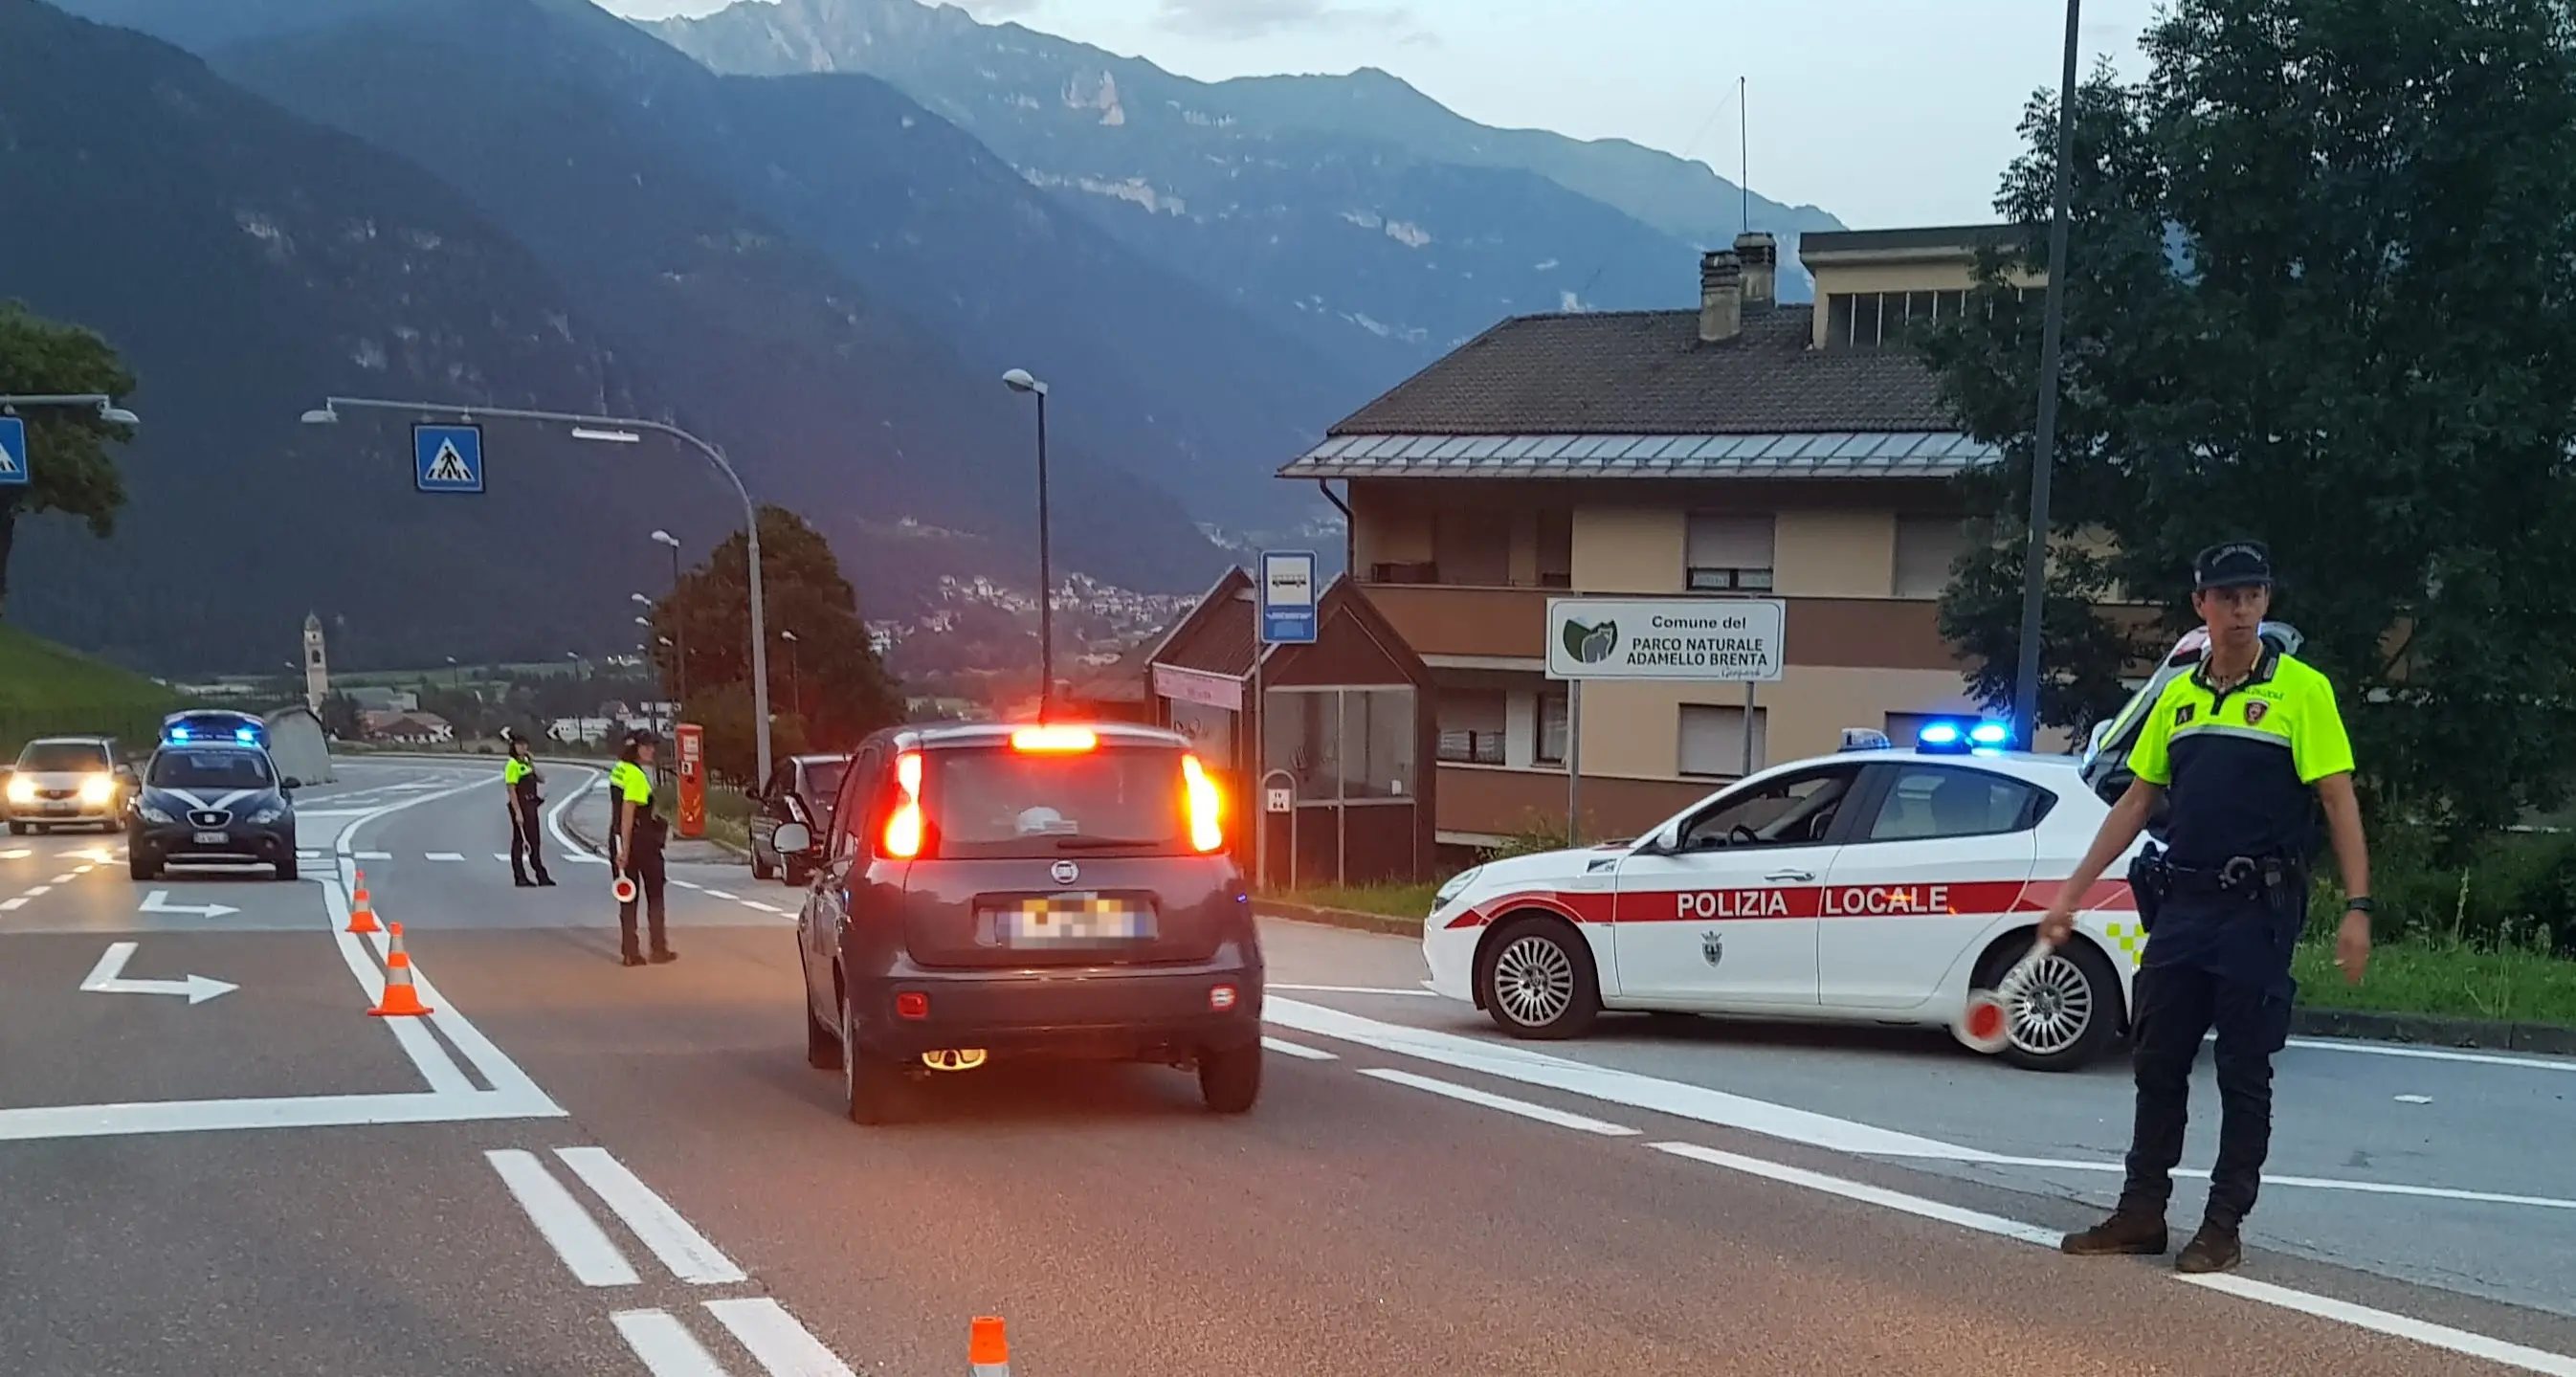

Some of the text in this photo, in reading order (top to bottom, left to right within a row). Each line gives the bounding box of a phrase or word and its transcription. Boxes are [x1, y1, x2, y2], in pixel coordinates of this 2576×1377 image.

[1652, 615, 1746, 630] Comune del
[1632, 637, 1763, 652] PARCO NATURALE
[1627, 652, 1767, 666] ADAMELLO BRENTA
[1677, 886, 1948, 918] POLIZIA LOCALE
